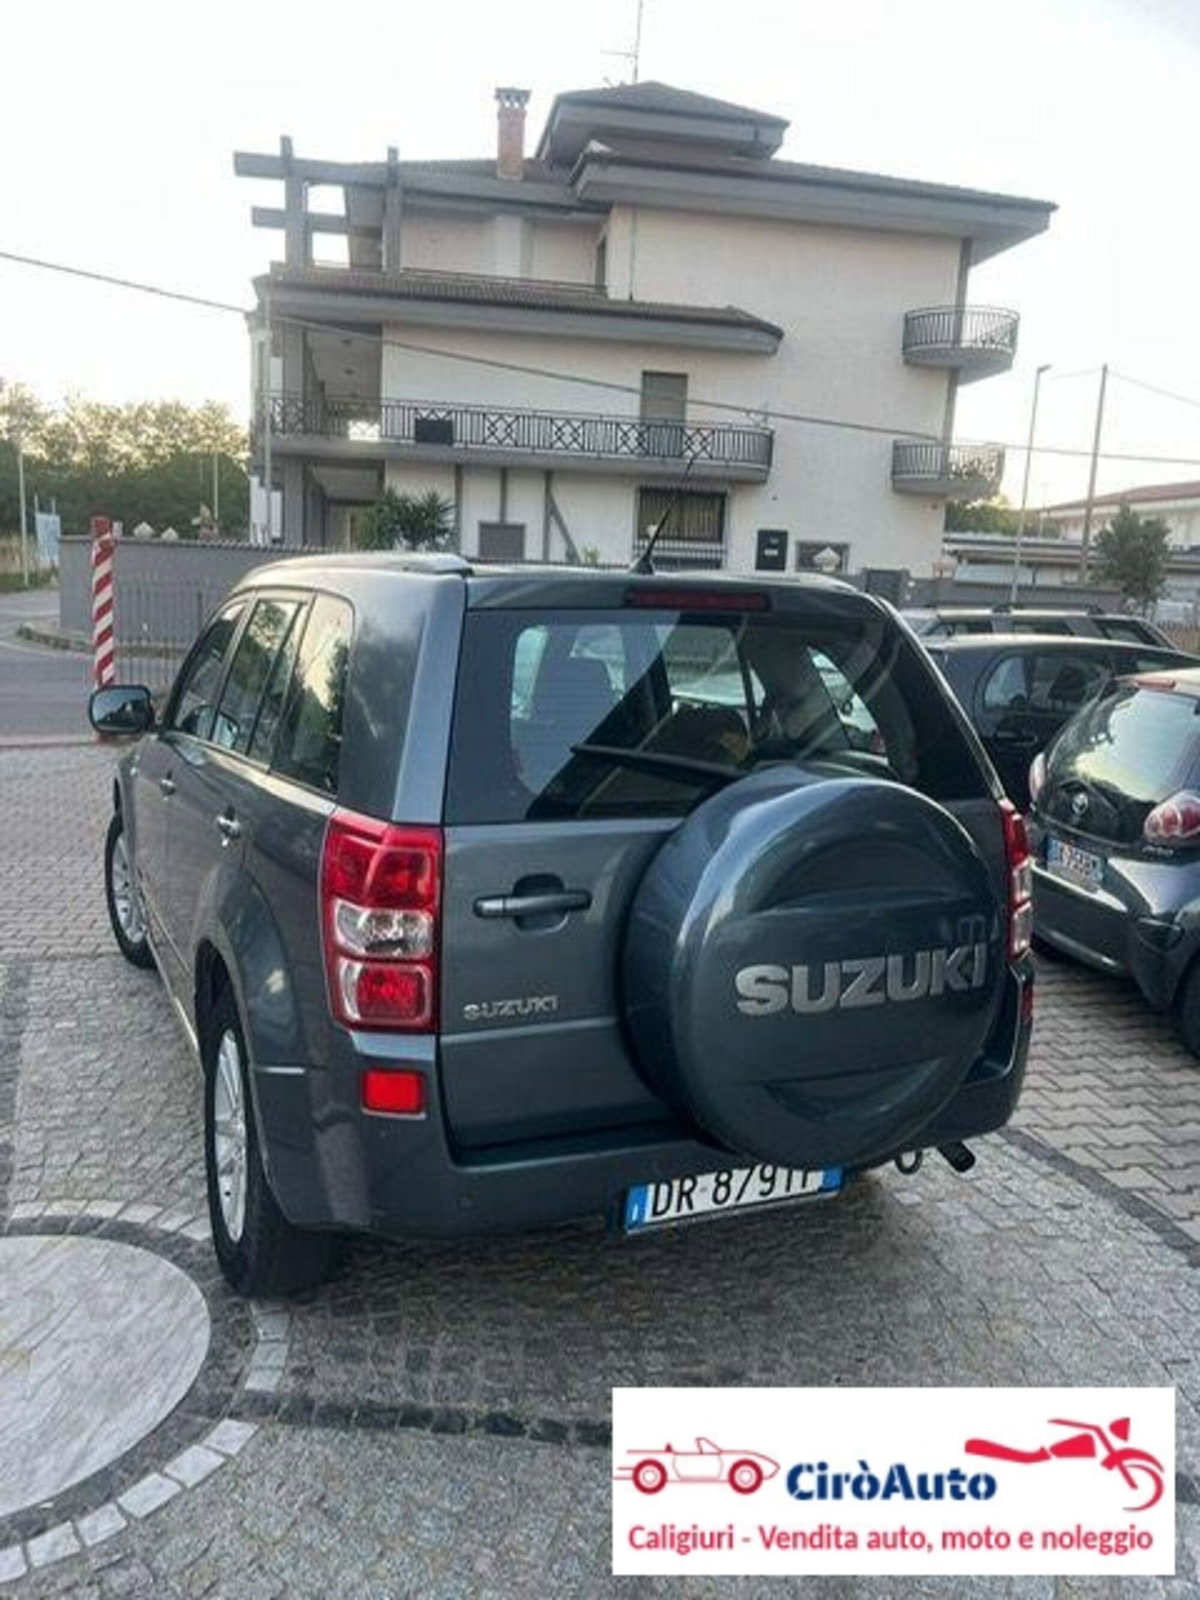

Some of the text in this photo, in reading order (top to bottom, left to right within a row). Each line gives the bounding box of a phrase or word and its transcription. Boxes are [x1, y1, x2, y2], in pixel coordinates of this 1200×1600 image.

[735, 944, 986, 1016] SUZUKI
[463, 995, 559, 1020] SUZUKI
[651, 1174, 697, 1217] DR
